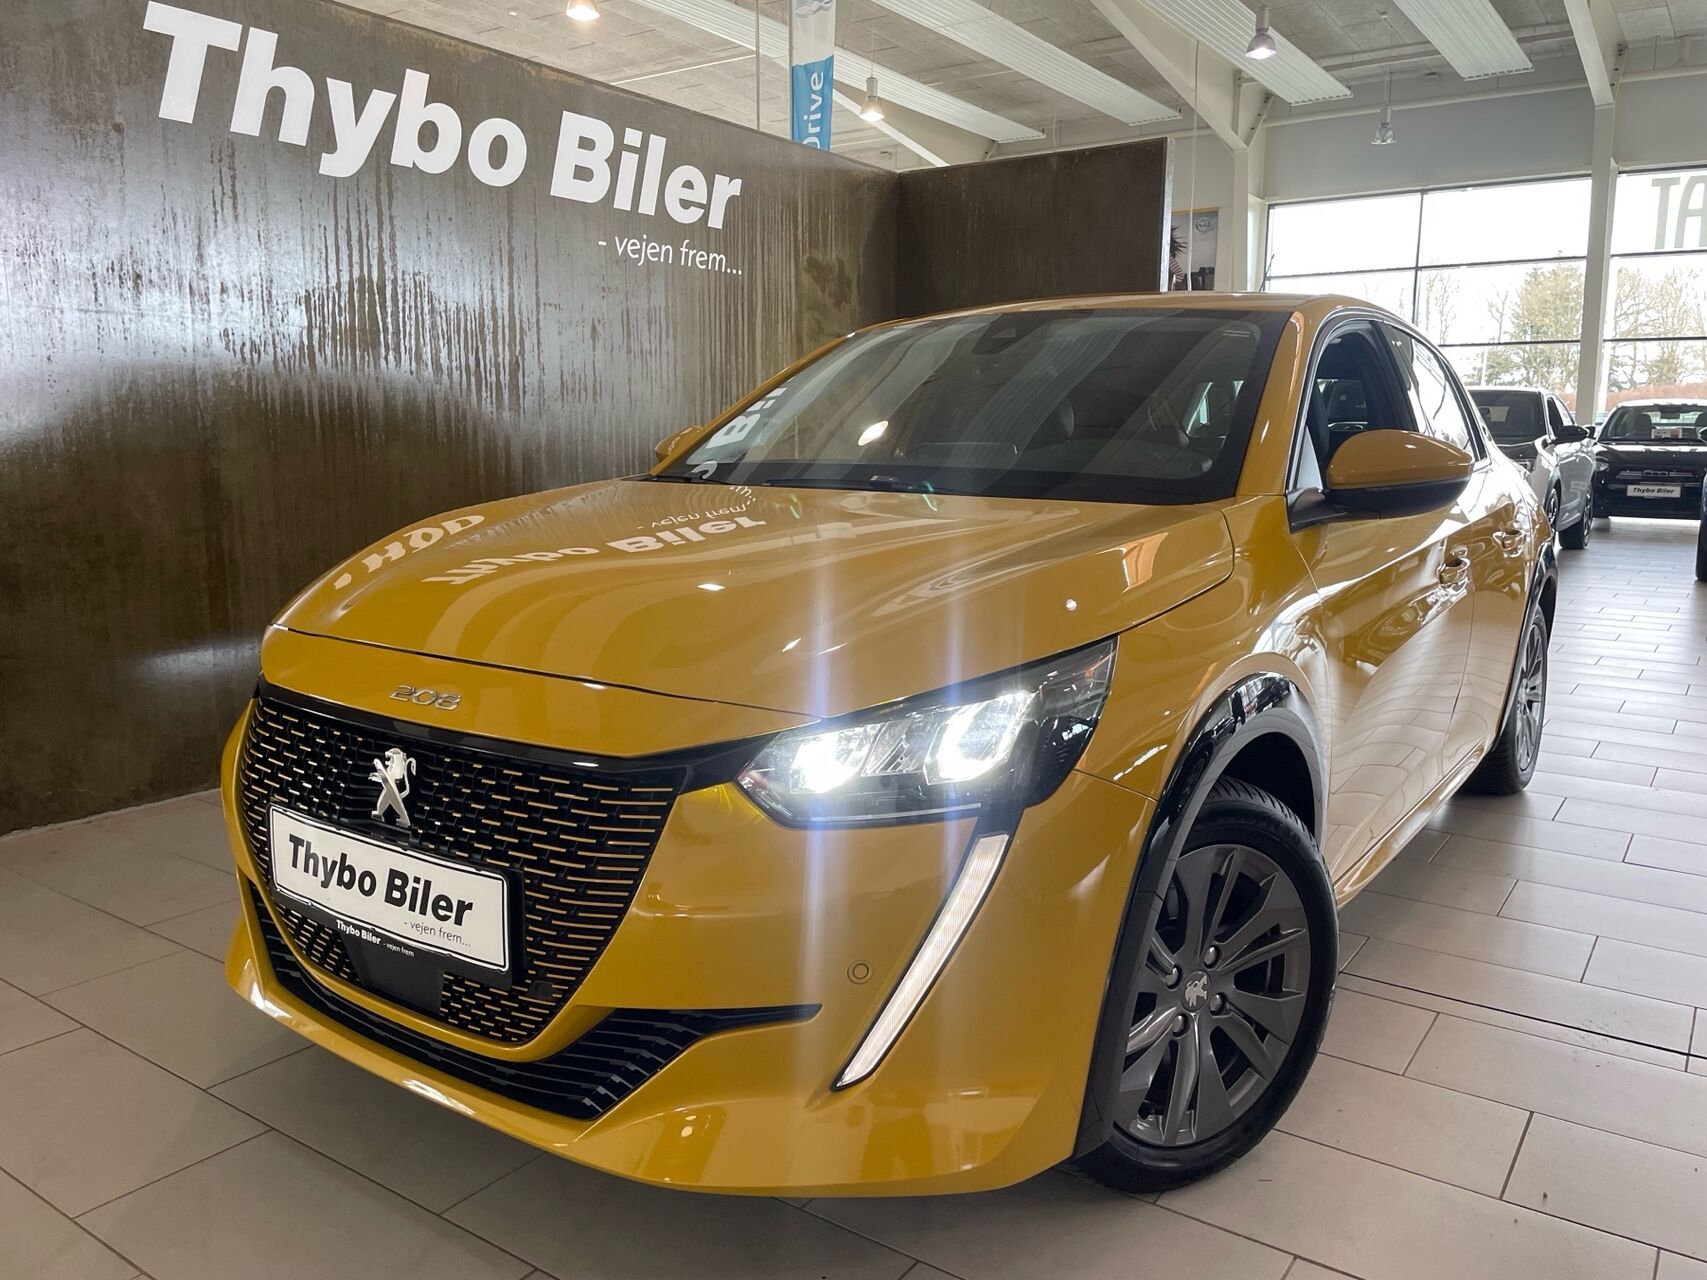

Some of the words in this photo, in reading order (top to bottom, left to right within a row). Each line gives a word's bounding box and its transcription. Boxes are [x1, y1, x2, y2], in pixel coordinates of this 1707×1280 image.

[143, 0, 527, 187] Thybo
[549, 110, 742, 229] Biler
[614, 234, 673, 266] vejen
[680, 239, 742, 275] frem...
[390, 685, 461, 710] 208
[289, 833, 376, 897] Thybo
[384, 868, 473, 926] Biler
[336, 919, 360, 937] Thybo
[361, 929, 381, 945] Biler
[410, 921, 436, 936] vejen
[438, 927, 471, 947] frem...
